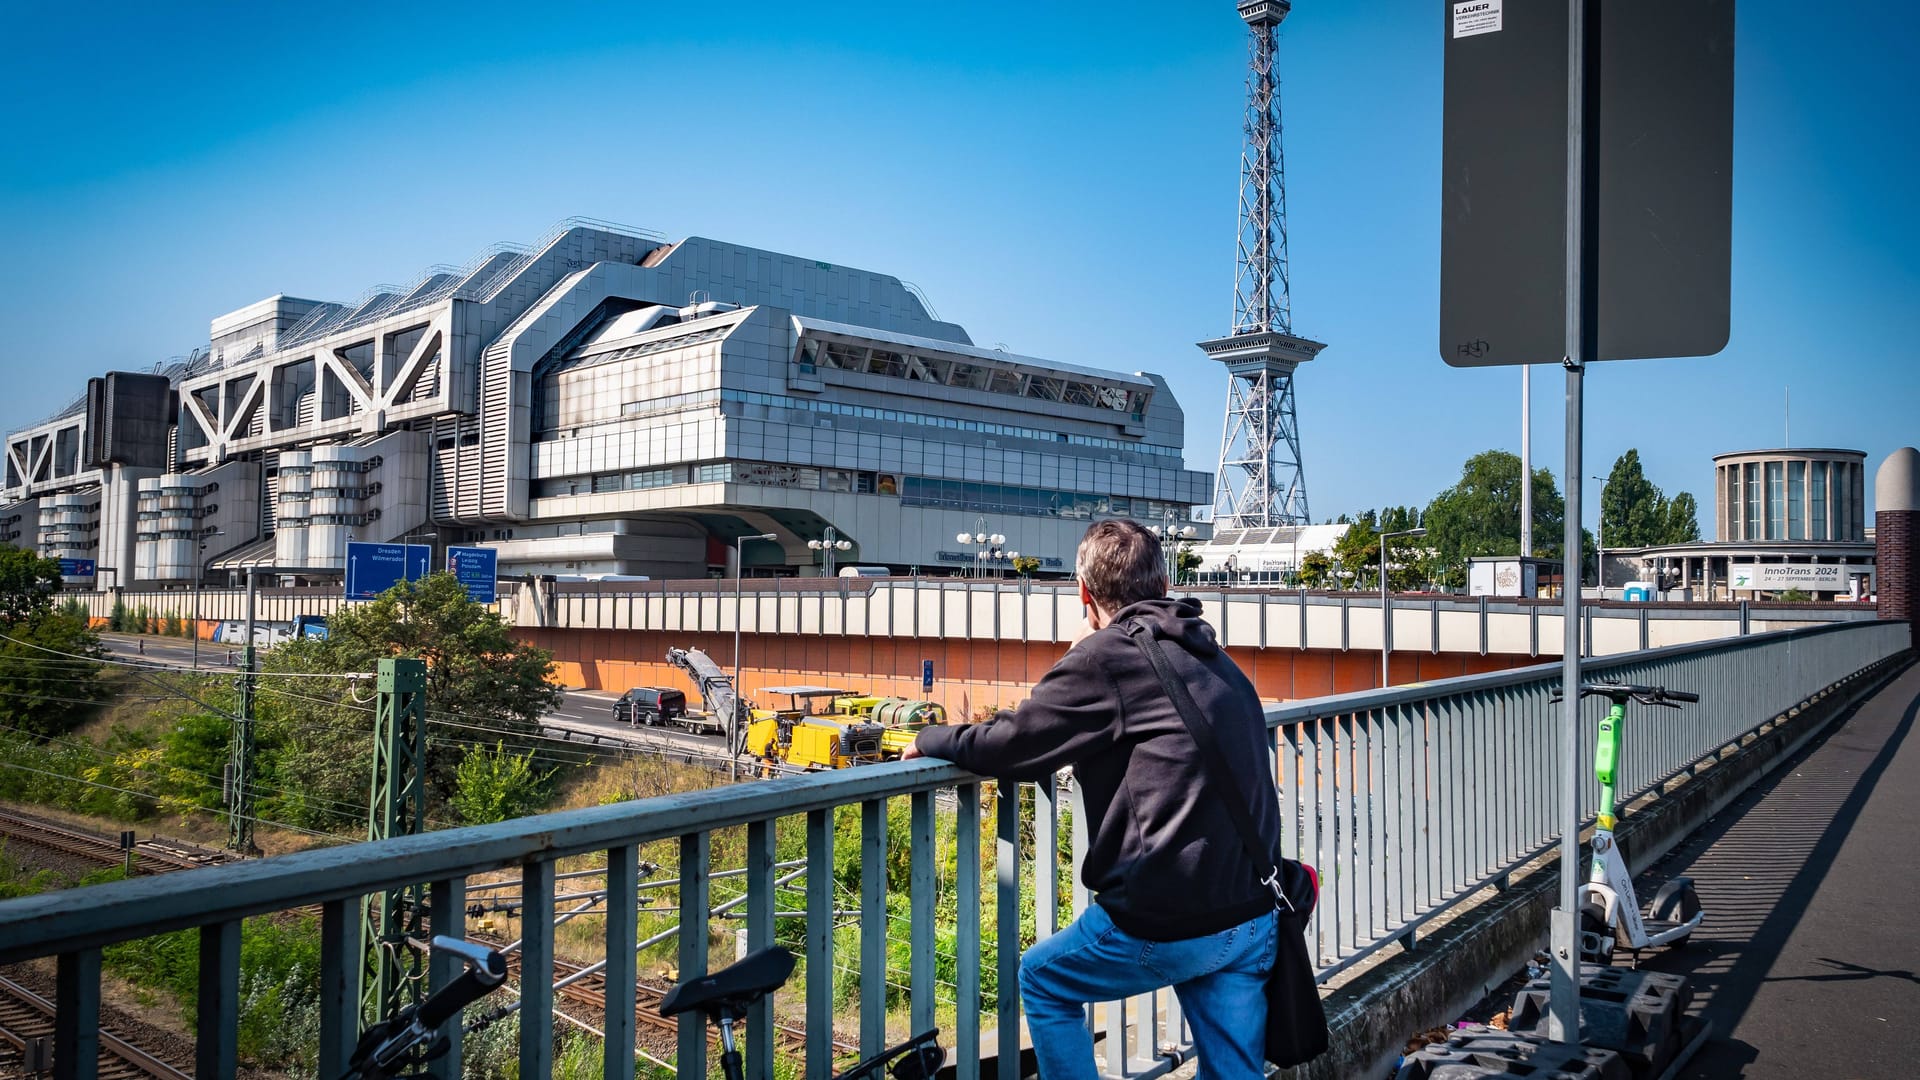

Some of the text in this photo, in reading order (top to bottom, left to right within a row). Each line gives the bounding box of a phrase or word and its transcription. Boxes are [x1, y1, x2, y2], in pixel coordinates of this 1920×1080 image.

[1455, 4, 1489, 14] LAUER
[377, 547, 402, 555] Dresden
[1763, 567, 1838, 576] InnoTrans 2024
